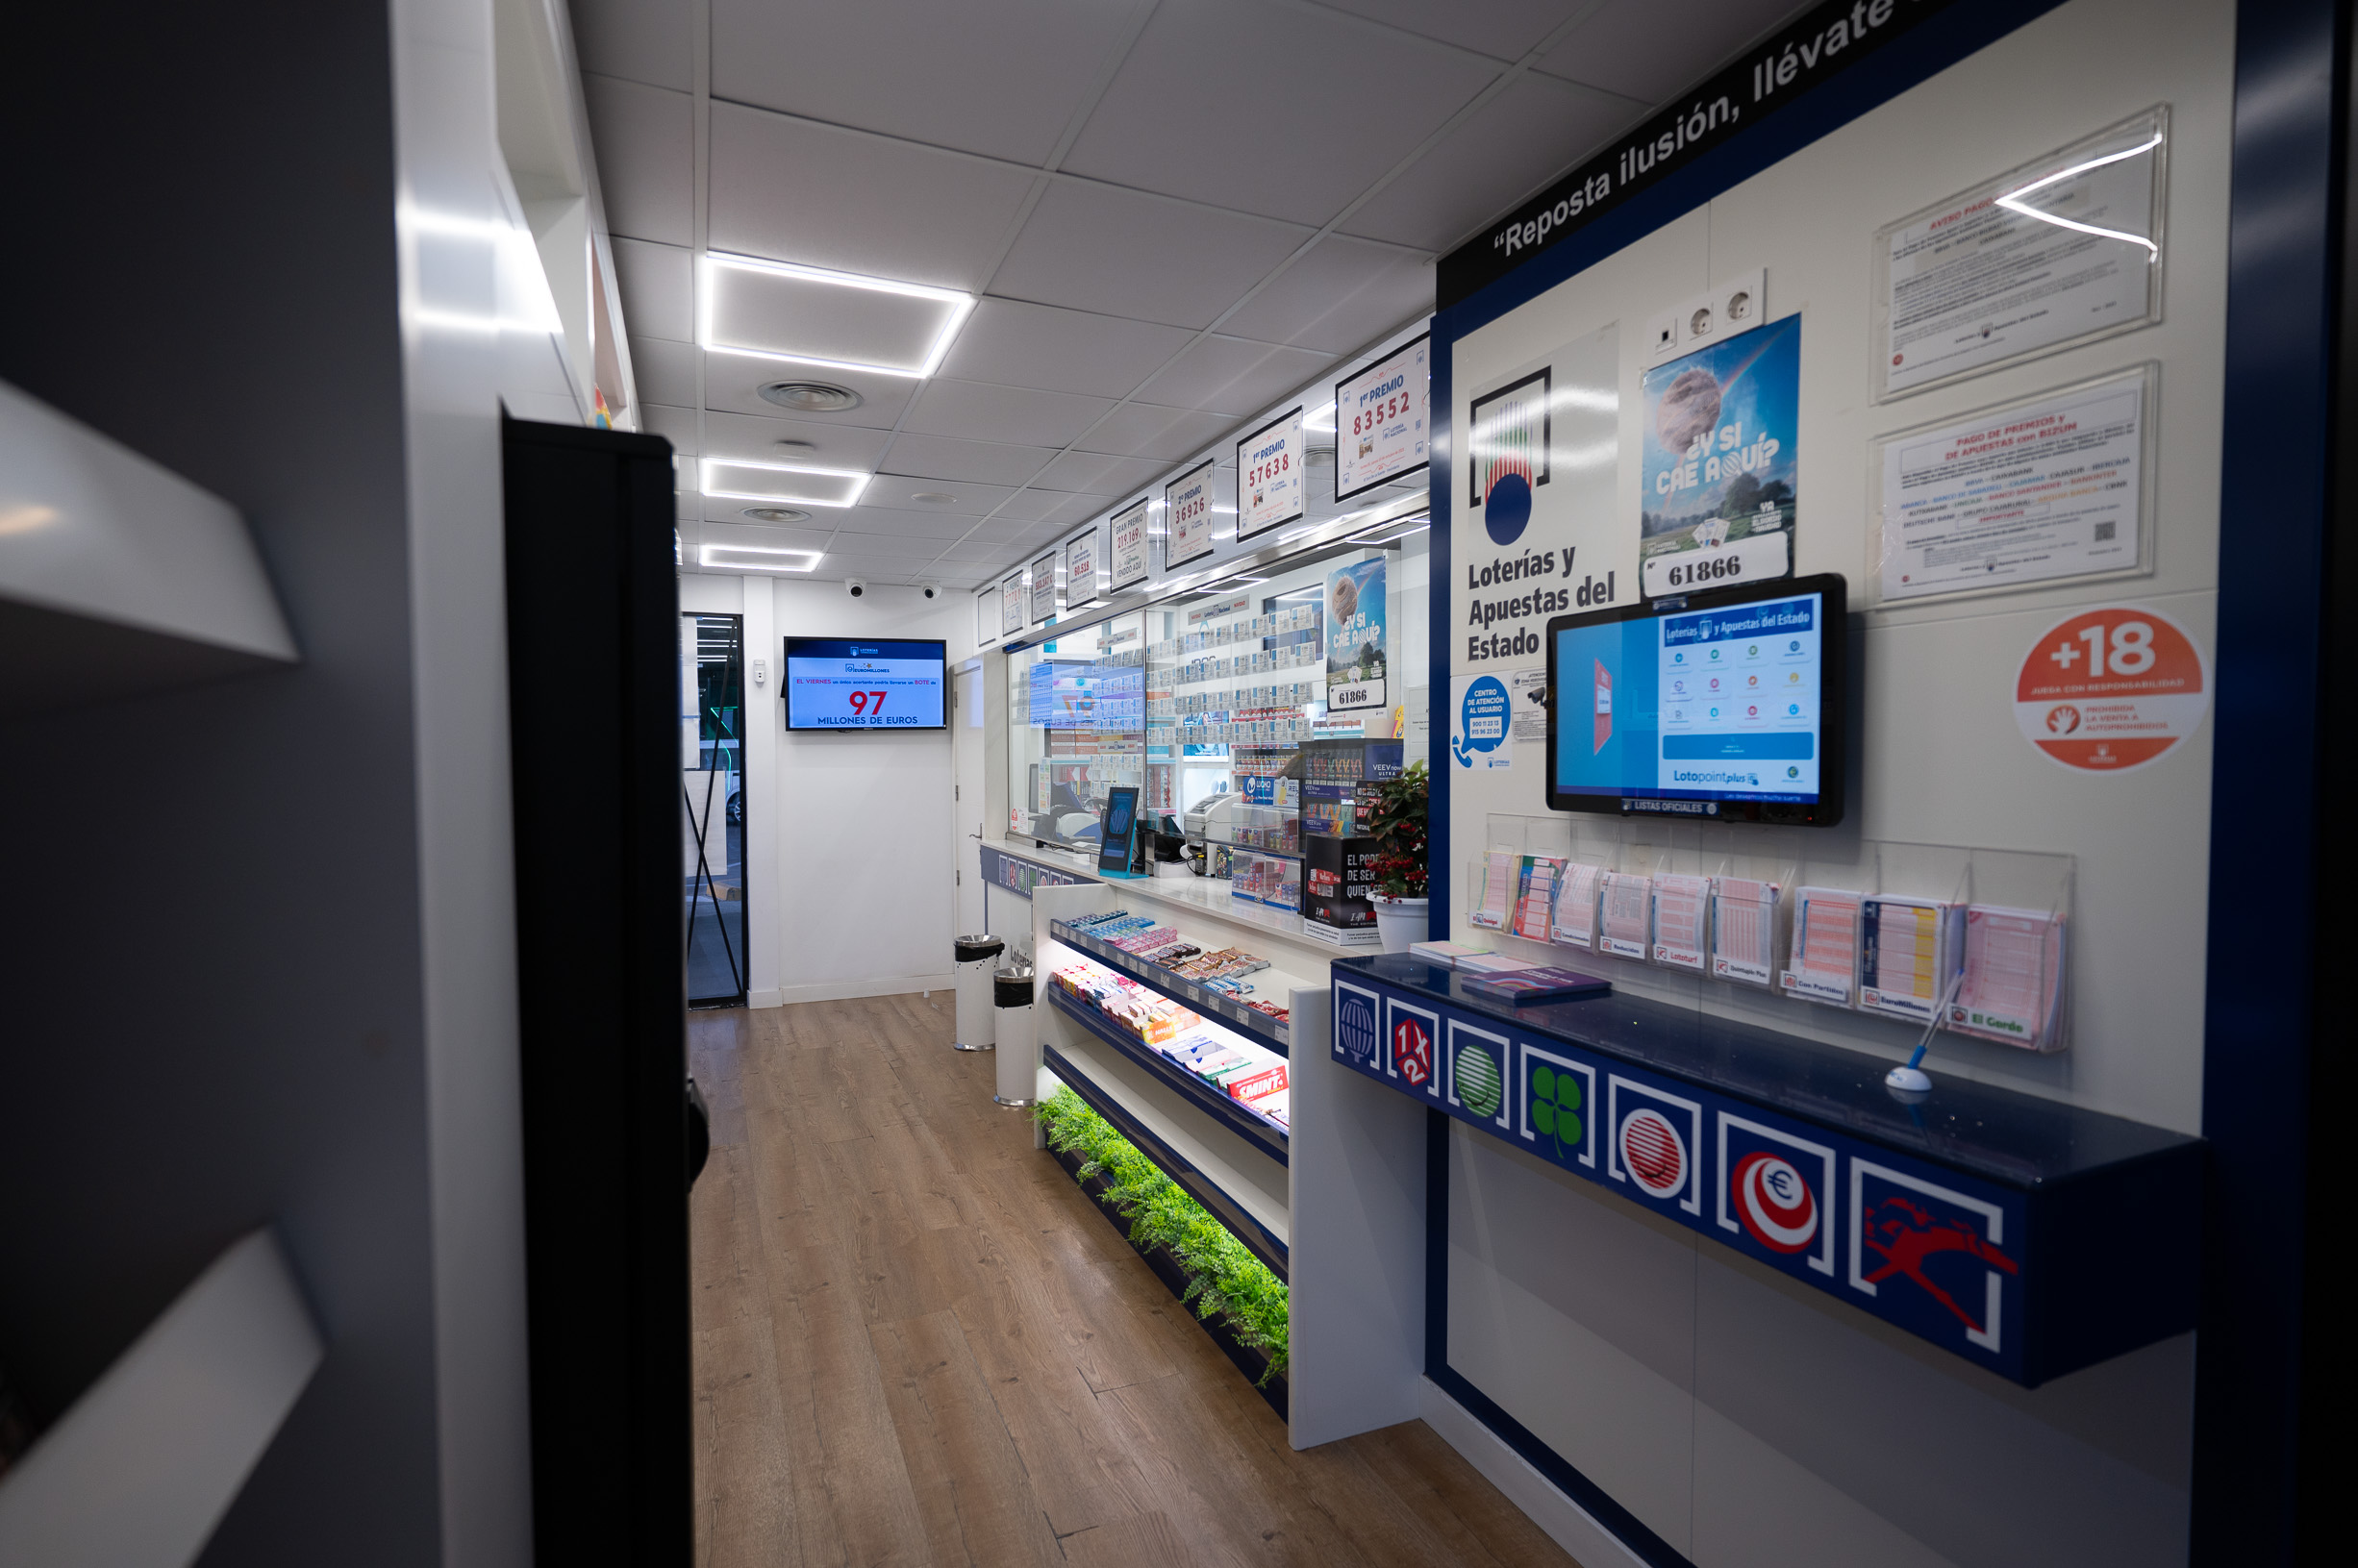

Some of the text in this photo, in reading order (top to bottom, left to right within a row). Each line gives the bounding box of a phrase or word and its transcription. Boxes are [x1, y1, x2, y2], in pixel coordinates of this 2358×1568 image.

[1619, 95, 1741, 186] ilusión,
[1753, 0, 1894, 101] llévate
[1360, 374, 1404, 408] 1er PREMIO
[1353, 391, 1410, 436] 83552
[1687, 421, 1742, 460] ¿Y SI
[1945, 421, 2077, 461] DE APUESTAS con BIZUM
[1957, 433, 1985, 447] PAGO
[1988, 429, 2001, 439] DE
[2005, 416, 2056, 436] PREMIOS
[1261, 438, 1285, 460] PREMIO
[1249, 453, 1289, 487] 57638
[1656, 432, 1779, 495] CAE AQUÍ?
[1184, 485, 1202, 502] PREMIO
[1175, 496, 1205, 525] 36926
[1116, 513, 1143, 535] GRAN PREMIO
[1116, 564, 1133, 578] VENDIDO
[1468, 546, 1576, 590] Loterías y
[1668, 555, 1742, 586] 61866
[1468, 570, 1615, 631] Apuestas del
[1357, 611, 1366, 628] SI
[1667, 610, 1810, 639] Loterías y Apuestas del Estado
[1333, 620, 1380, 648] CAE AQUÍ?
[1467, 627, 1540, 662] Estado
[2050, 620, 2156, 677] +18
[1339, 688, 1367, 705] 61866
[1474, 688, 1497, 697] CENTRO
[2031, 678, 2185, 695] JUEGA CON RESPONSABILIDAD
[849, 690, 888, 715] 97
[1476, 696, 1505, 706] ATENCIÓN
[1477, 705, 1503, 713] USUARIO
[2086, 705, 2135, 713] PROHIBIDA
[817, 716, 865, 725] MILLONES
[869, 716, 882, 725] DE
[2099, 714, 2129, 723] VENTA
[1635, 800, 1702, 813] LISTAS OFICIALES
[1347, 853, 1381, 866] EL PODE
[1347, 869, 1376, 881] DE SER
[1346, 884, 1371, 899] QUIEN
[1670, 952, 1697, 963] Lototurf
[1881, 996, 1931, 1012] EuroMillones
[1155, 1025, 1172, 1035] HALLS
[1972, 1013, 2023, 1033] El Gordo
[1239, 1074, 1279, 1098] SMINT
